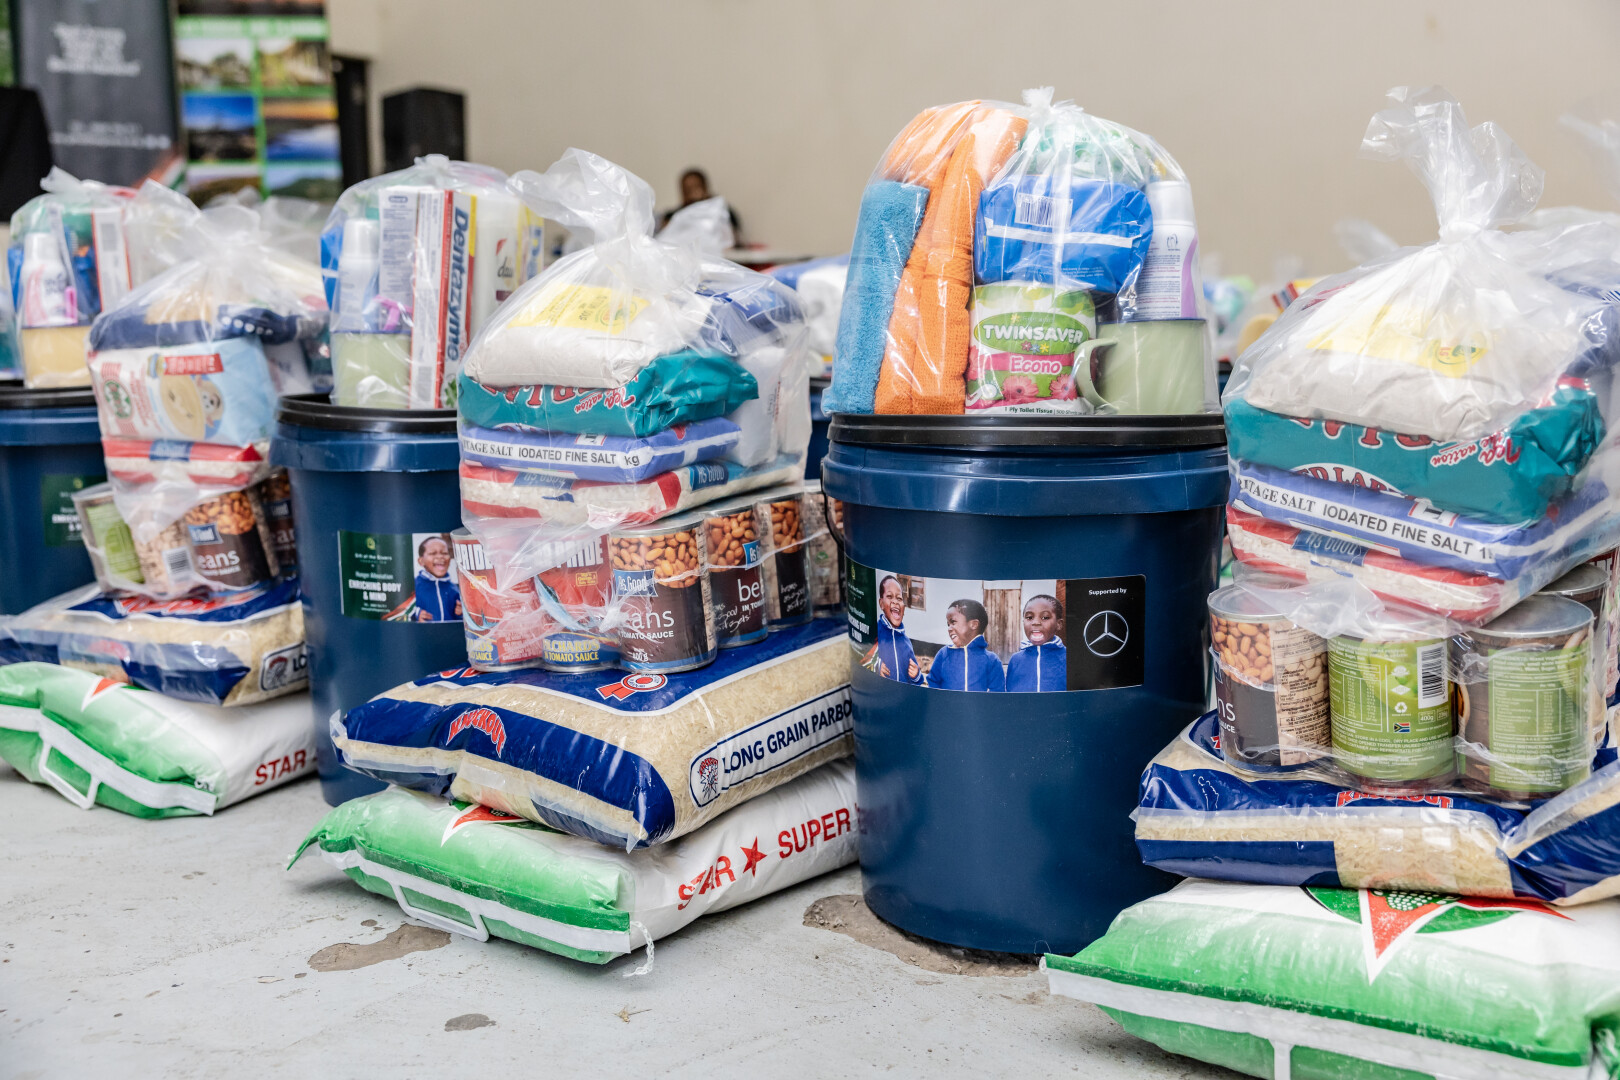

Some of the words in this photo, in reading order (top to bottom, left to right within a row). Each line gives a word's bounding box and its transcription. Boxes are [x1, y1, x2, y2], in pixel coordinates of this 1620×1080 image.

[447, 207, 469, 361] Dentazyme
[983, 324, 1083, 344] TWINSAVER
[1010, 355, 1062, 375] Econo
[490, 444, 513, 456] SALT
[518, 447, 562, 461] IODATED
[565, 451, 588, 463] FINE
[591, 453, 617, 464] SALT
[624, 454, 640, 466] kg
[1431, 444, 1477, 465] nation
[1281, 493, 1316, 513] SALT
[1323, 503, 1388, 532] IODATED
[1391, 523, 1428, 543] FINE
[1431, 533, 1473, 555] SALT
[348, 579, 381, 592] ENRICHING
[382, 583, 402, 592] BODY
[1088, 588, 1119, 596] Supported
[369, 592, 387, 602] MIND
[646, 630, 674, 639] SAUCE
[549, 652, 573, 662] TOMATO
[575, 651, 600, 662] SAUCE
[722, 741, 765, 774] LONG
[766, 719, 809, 754] GRAIN
[811, 699, 853, 733] PARBO
[254, 749, 306, 786] STAR
[677, 855, 736, 911] STAR
[777, 807, 851, 859] SUPER
